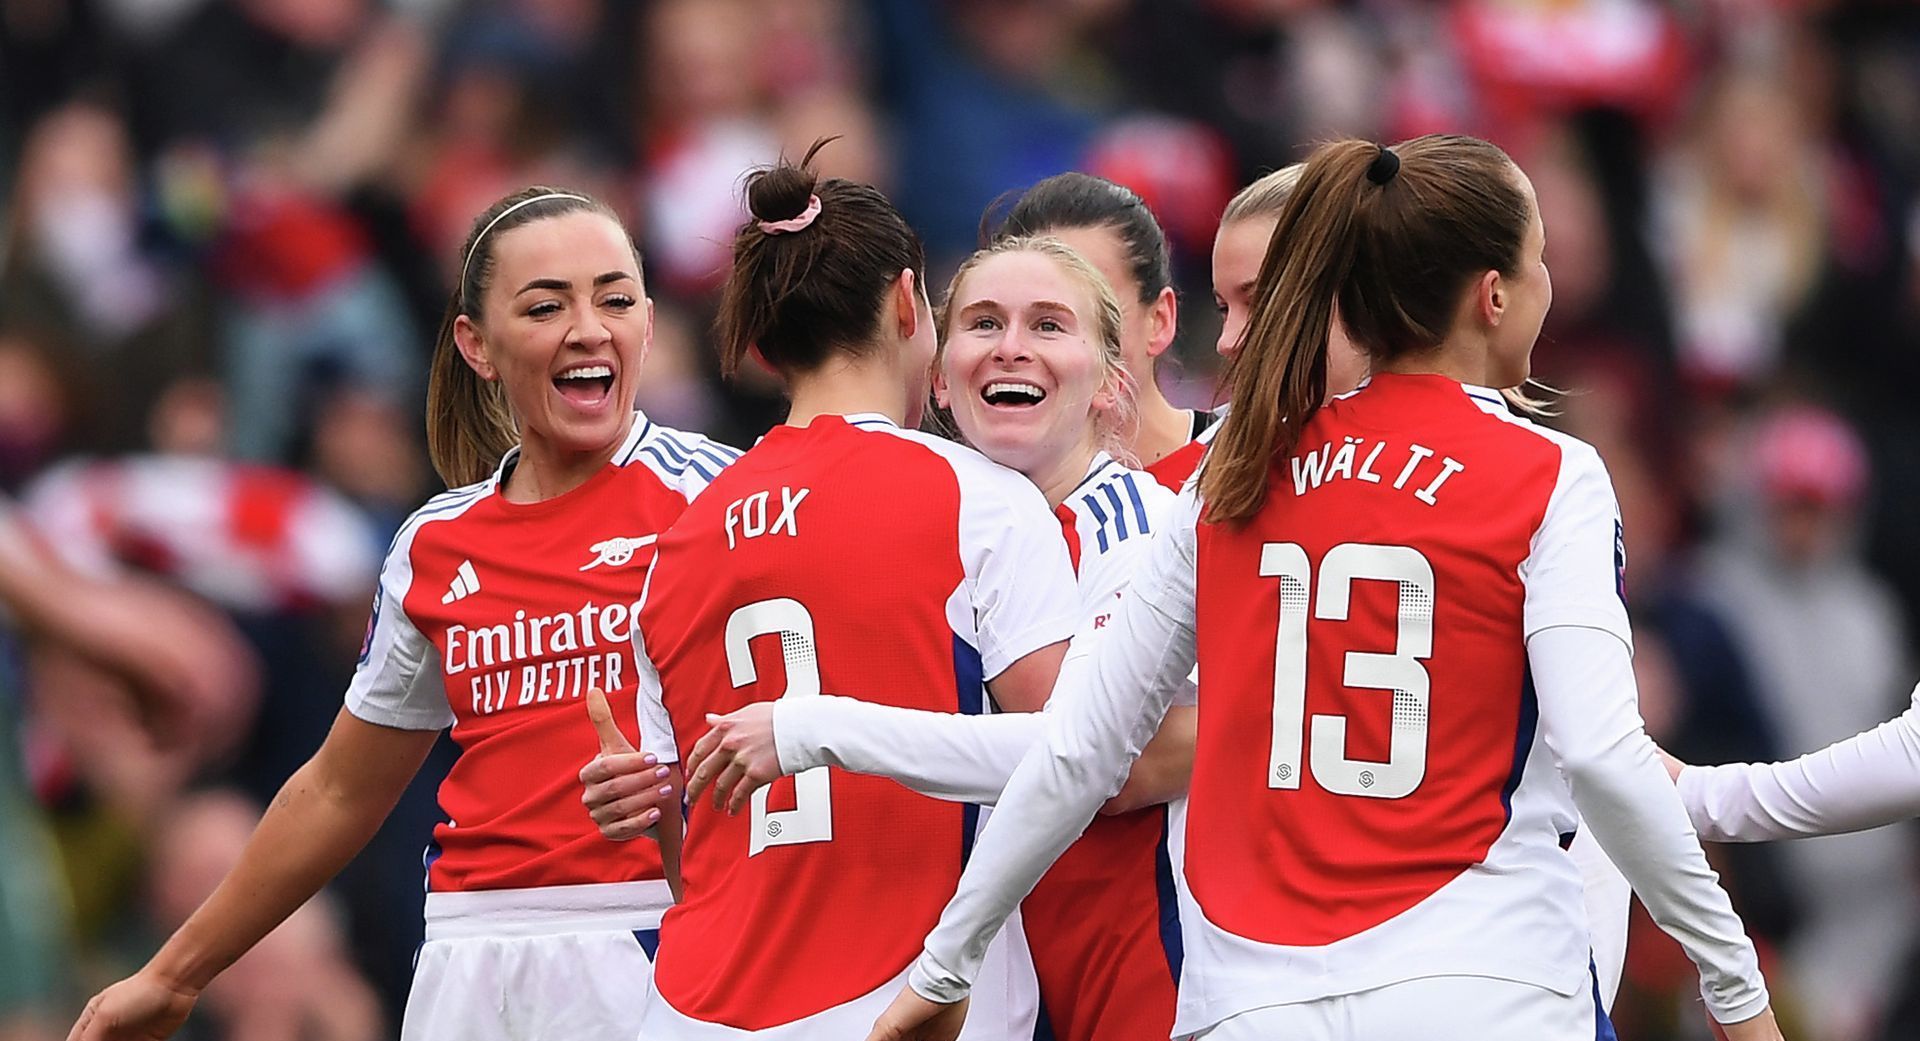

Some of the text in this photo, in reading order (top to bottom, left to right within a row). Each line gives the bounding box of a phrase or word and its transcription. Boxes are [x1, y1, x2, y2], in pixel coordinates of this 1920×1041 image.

[1291, 436, 1464, 505] WÄLTI
[724, 486, 811, 551] FOX
[445, 600, 638, 675] Emirate
[1259, 542, 1435, 799] 13
[470, 651, 623, 716] FLY BETTER
[724, 596, 833, 858] 2
